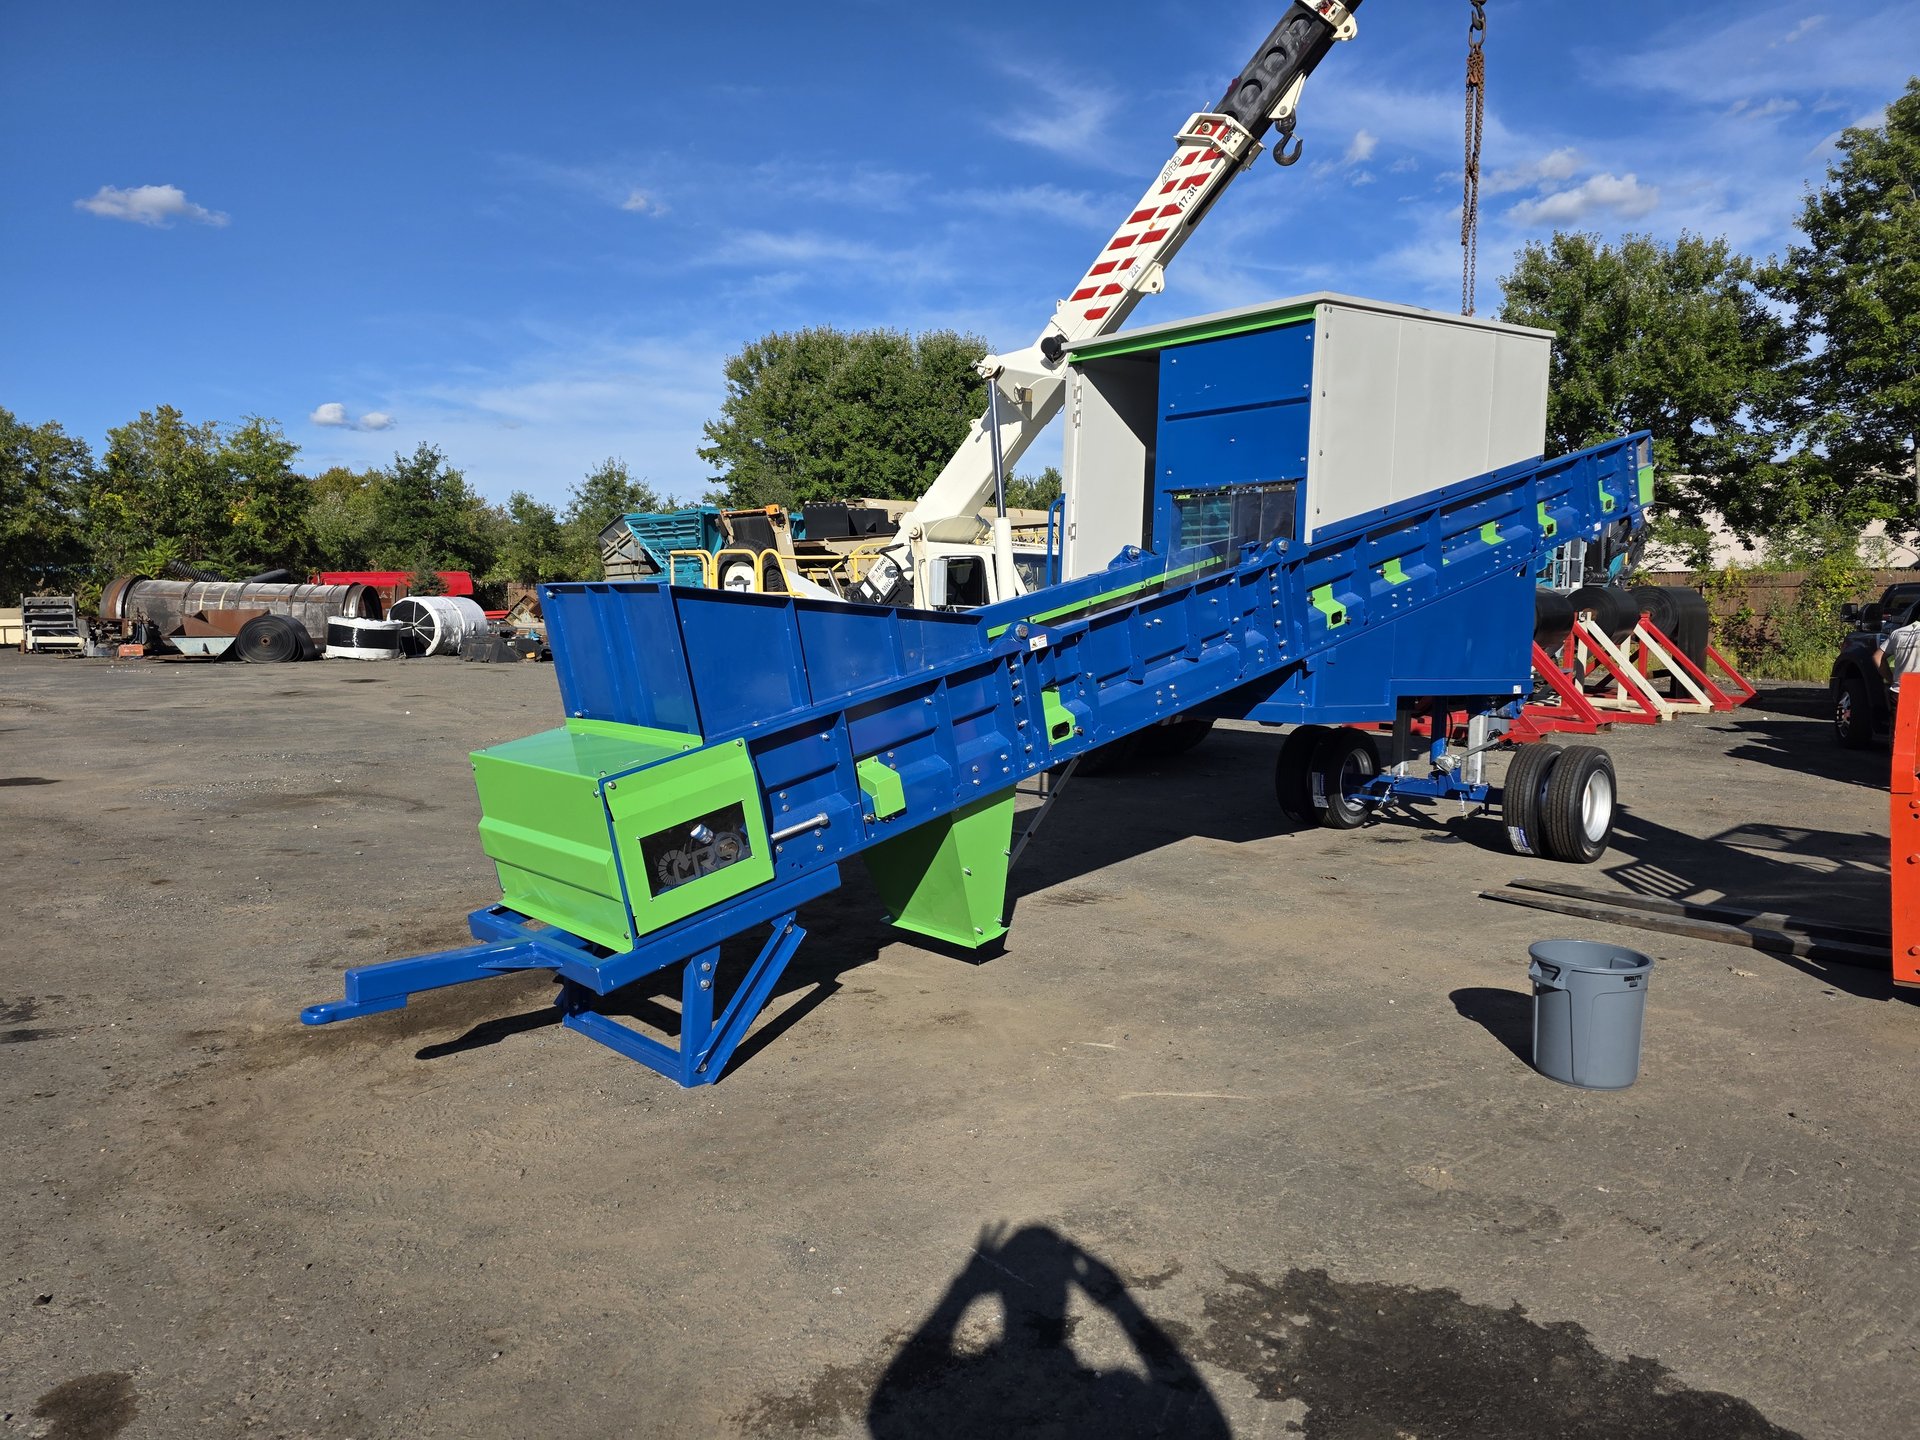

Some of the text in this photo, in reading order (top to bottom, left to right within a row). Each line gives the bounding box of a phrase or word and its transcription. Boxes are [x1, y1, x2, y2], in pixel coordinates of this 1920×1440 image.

[1161, 155, 1182, 185] AT22
[1178, 185, 1197, 207] 17.3t
[1128, 264, 1141, 278] 22t
[875, 556, 888, 573] TERE
